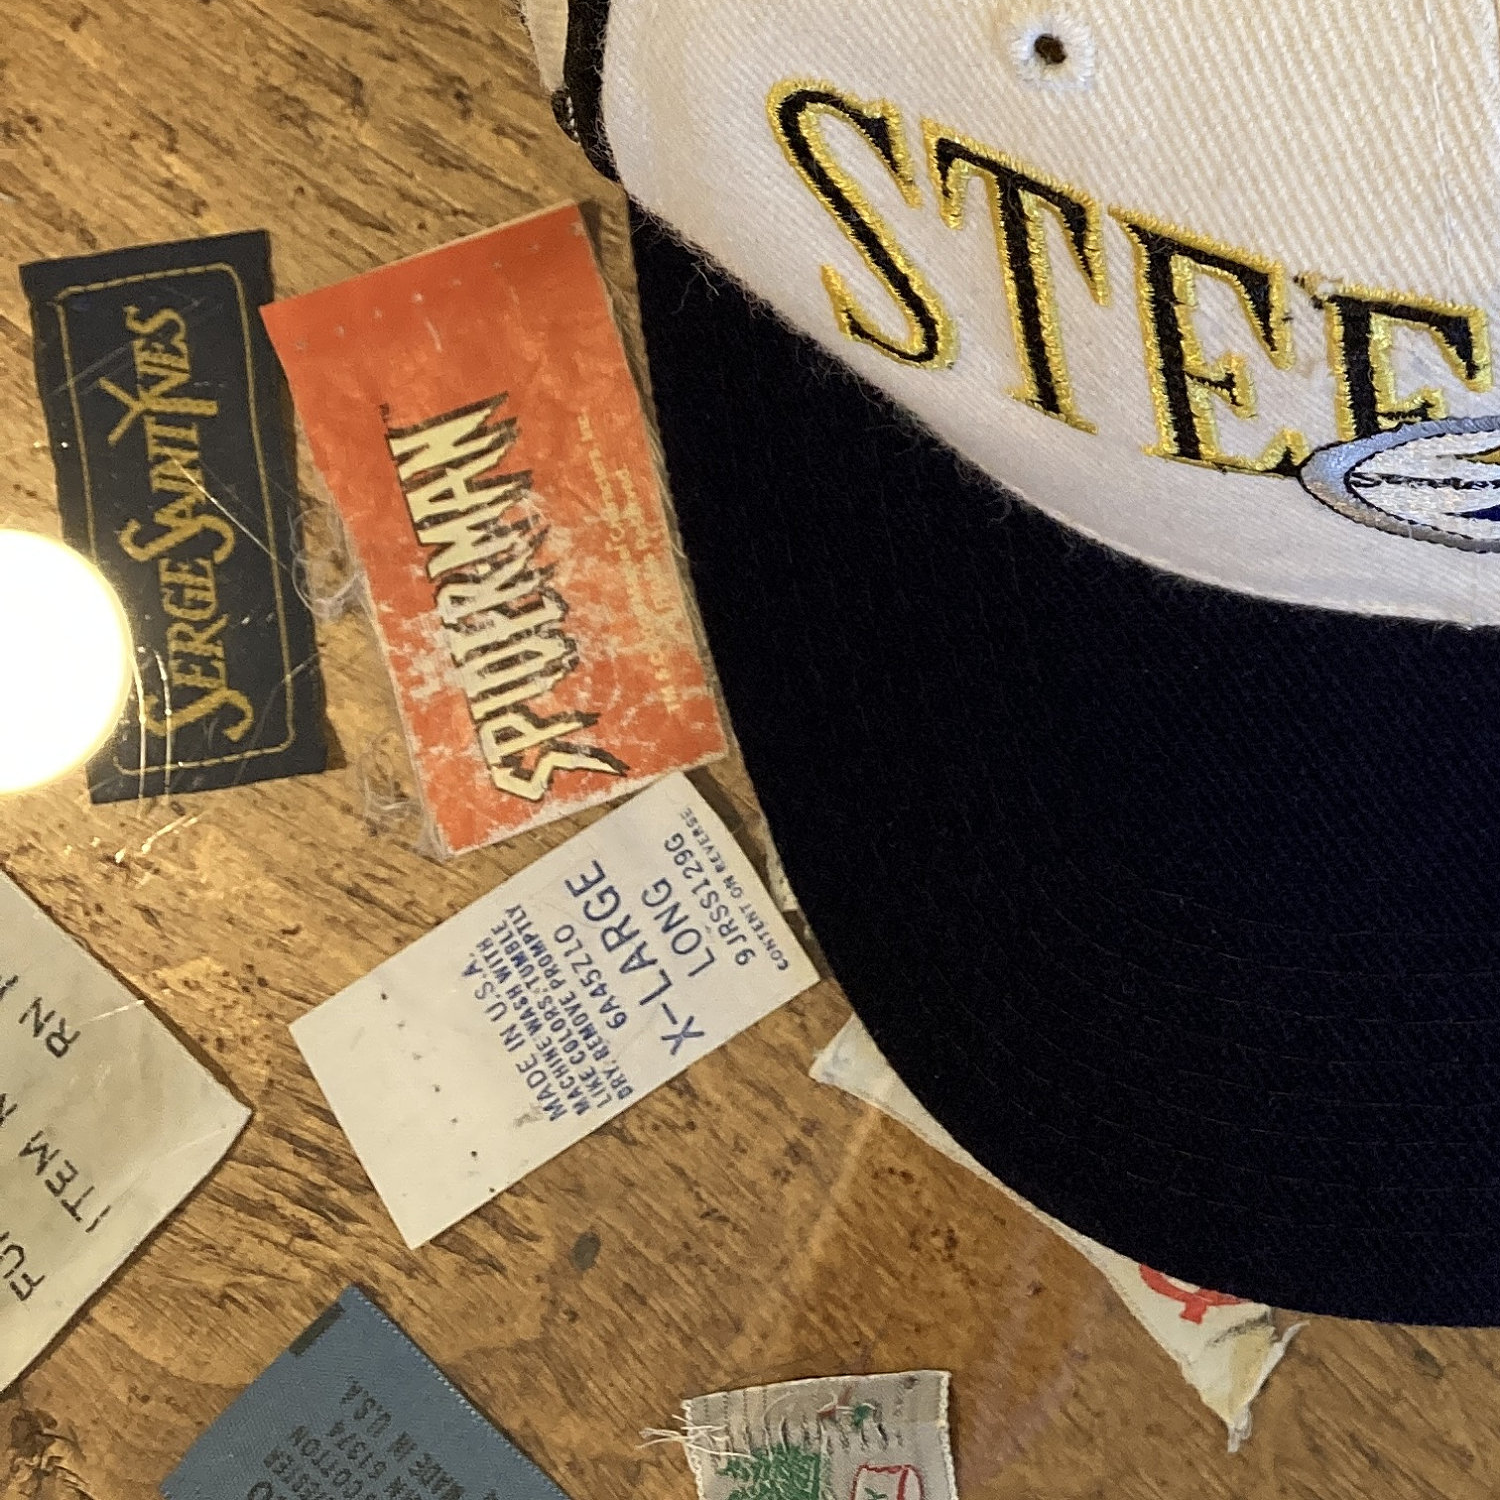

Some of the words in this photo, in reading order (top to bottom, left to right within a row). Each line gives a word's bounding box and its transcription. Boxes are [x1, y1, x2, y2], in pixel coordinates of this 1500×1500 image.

[97, 304, 218, 443] YVES
[117, 416, 234, 562] SAINT
[141, 557, 253, 739] SERGE
[679, 805, 728, 873] REVERSE
[721, 872, 745, 900] ON
[474, 935, 514, 984] WITH
[489, 917, 542, 990] TUMBLE
[504, 900, 567, 990] PROMPTLY
[562, 857, 704, 1057] X-LARGE
[636, 875, 717, 979] LONG
[739, 900, 790, 971] CONTENT
[454, 952, 510, 1022] U.S.A.
[504, 983, 545, 1036] WASH
[15, 996, 81, 1060] RN
[498, 1023, 527, 1051] IN
[556, 988, 611, 1062] REMOVE
[513, 1052, 568, 1122] MADE
[534, 1034, 592, 1115] MACHINE
[578, 1066, 613, 1108] LIKE
[13, 1128, 115, 1235] ITEM
[0, 1233, 48, 1301] FU
[285, 1423, 366, 1500] COTTON
[384, 1429, 420, 1464] IN
[406, 1451, 467, 1498] MADE
